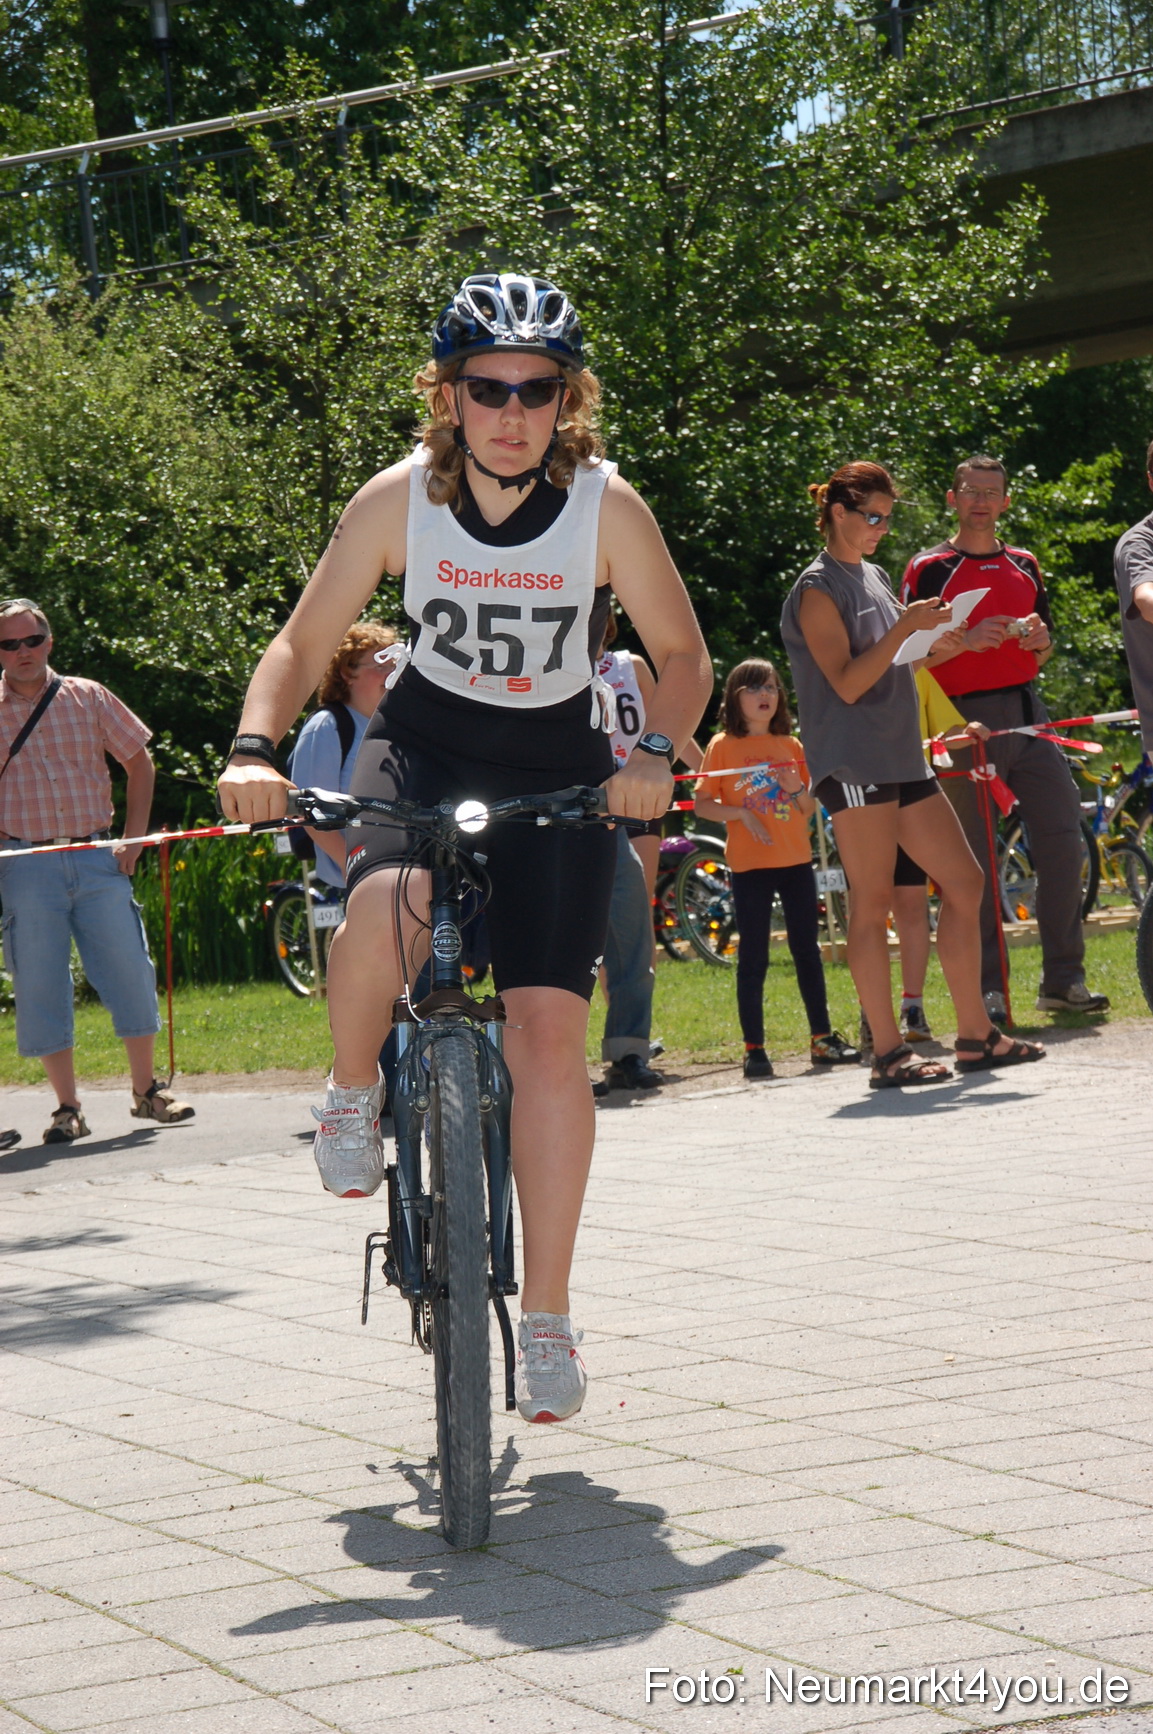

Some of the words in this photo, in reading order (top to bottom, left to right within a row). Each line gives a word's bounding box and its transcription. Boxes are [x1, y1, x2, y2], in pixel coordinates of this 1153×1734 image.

[437, 560, 564, 591] Sparkasse
[421, 598, 579, 677] 257
[820, 873, 844, 888] 451
[317, 910, 338, 922] 491
[532, 1332, 572, 1342] DIADORA
